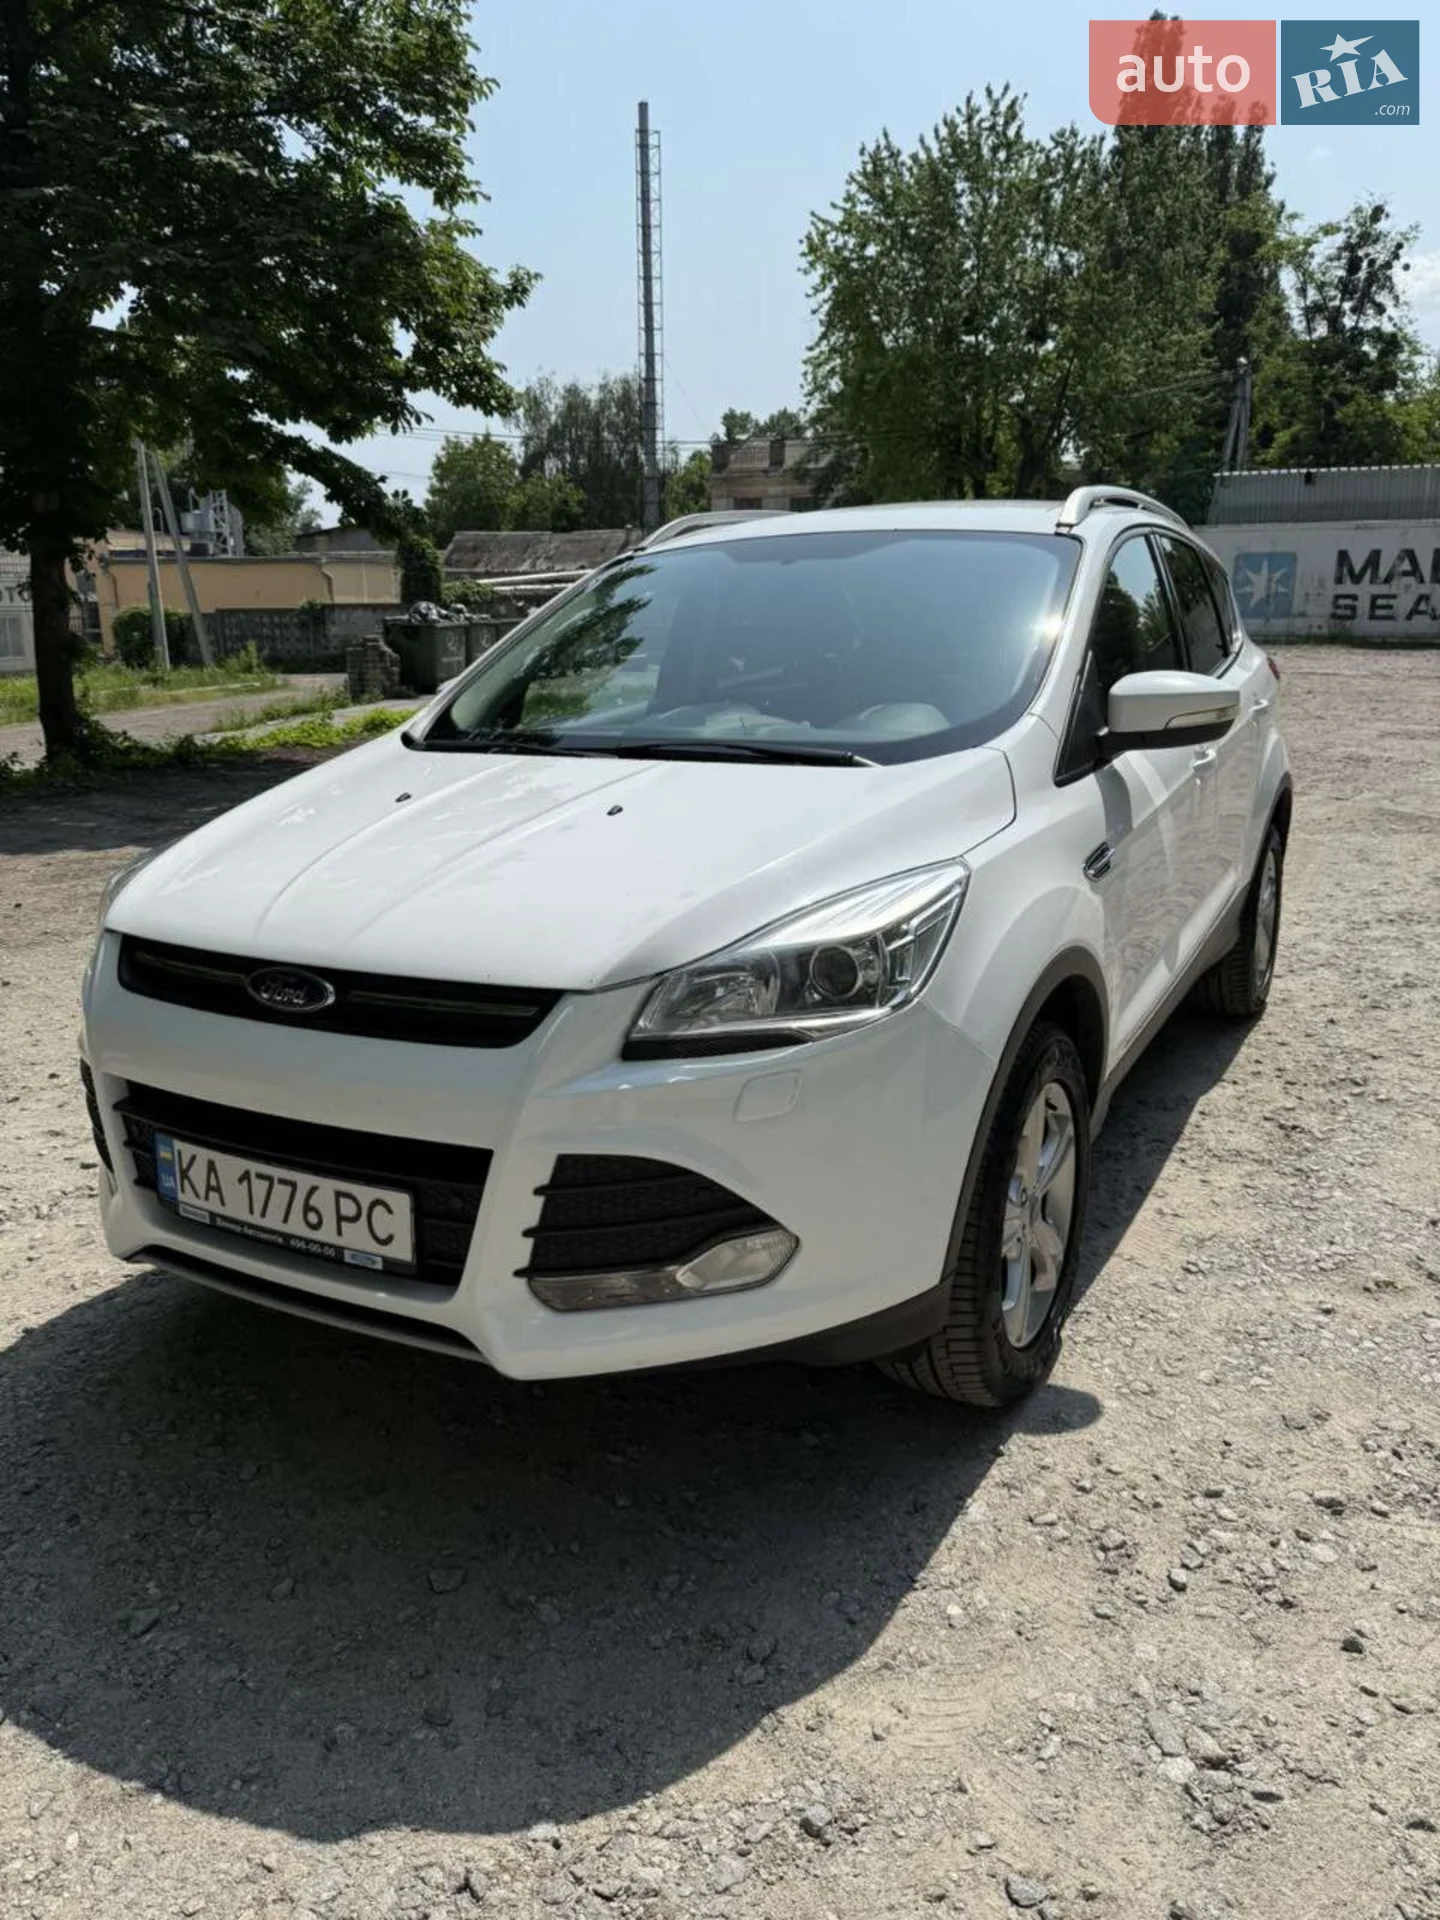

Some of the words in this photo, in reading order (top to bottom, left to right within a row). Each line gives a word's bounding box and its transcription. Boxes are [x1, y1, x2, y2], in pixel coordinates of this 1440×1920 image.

[1331, 593, 1440, 621] SEA
[259, 973, 308, 1005] Ford
[176, 1148, 226, 1207] KA
[237, 1169, 323, 1231] 1776
[334, 1189, 395, 1247] PC
